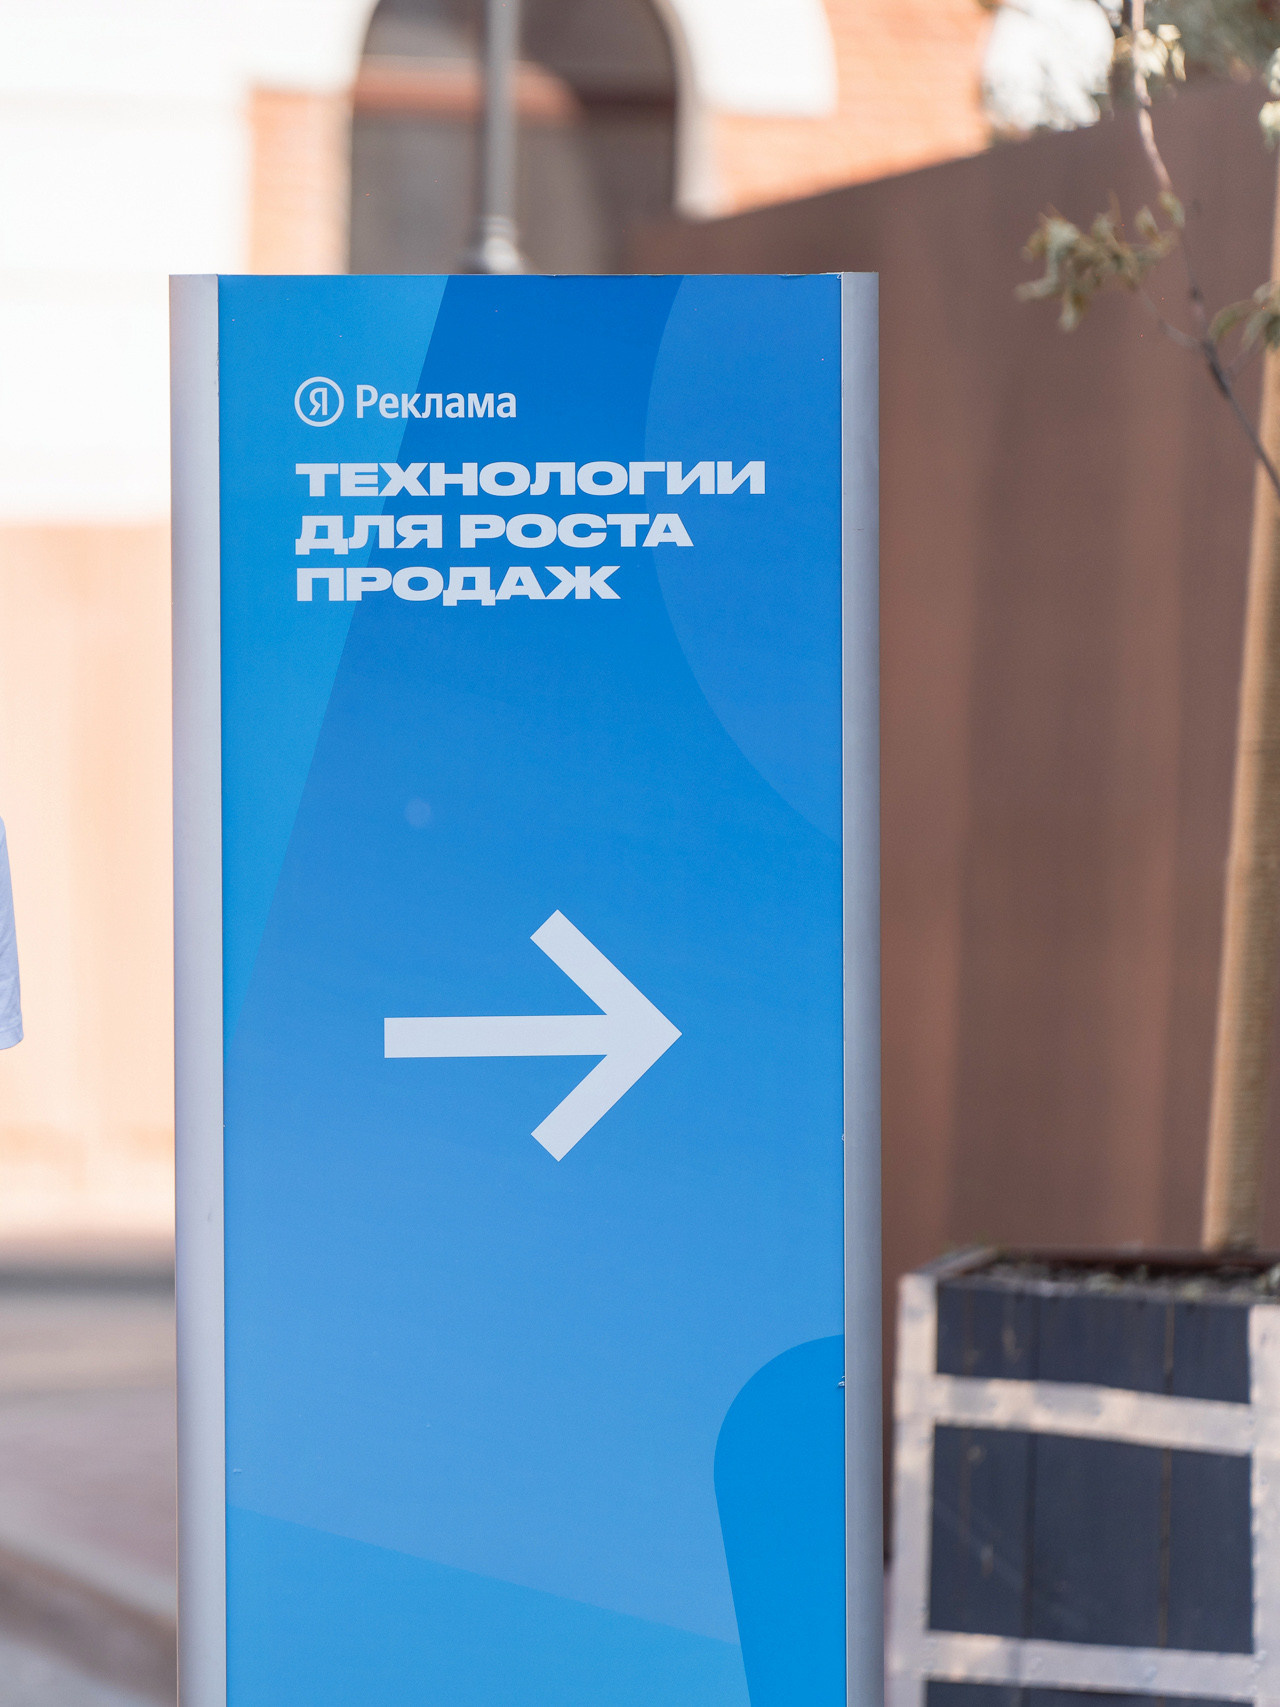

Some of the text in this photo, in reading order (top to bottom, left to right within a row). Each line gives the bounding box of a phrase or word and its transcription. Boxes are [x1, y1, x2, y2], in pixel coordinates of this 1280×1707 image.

[356, 384, 517, 419] Реклама
[295, 460, 766, 497] ТЕХНОЛОГИИ
[295, 513, 695, 556] ДЛЯ РОСТА
[296, 565, 621, 607] ПРОДАЖ
